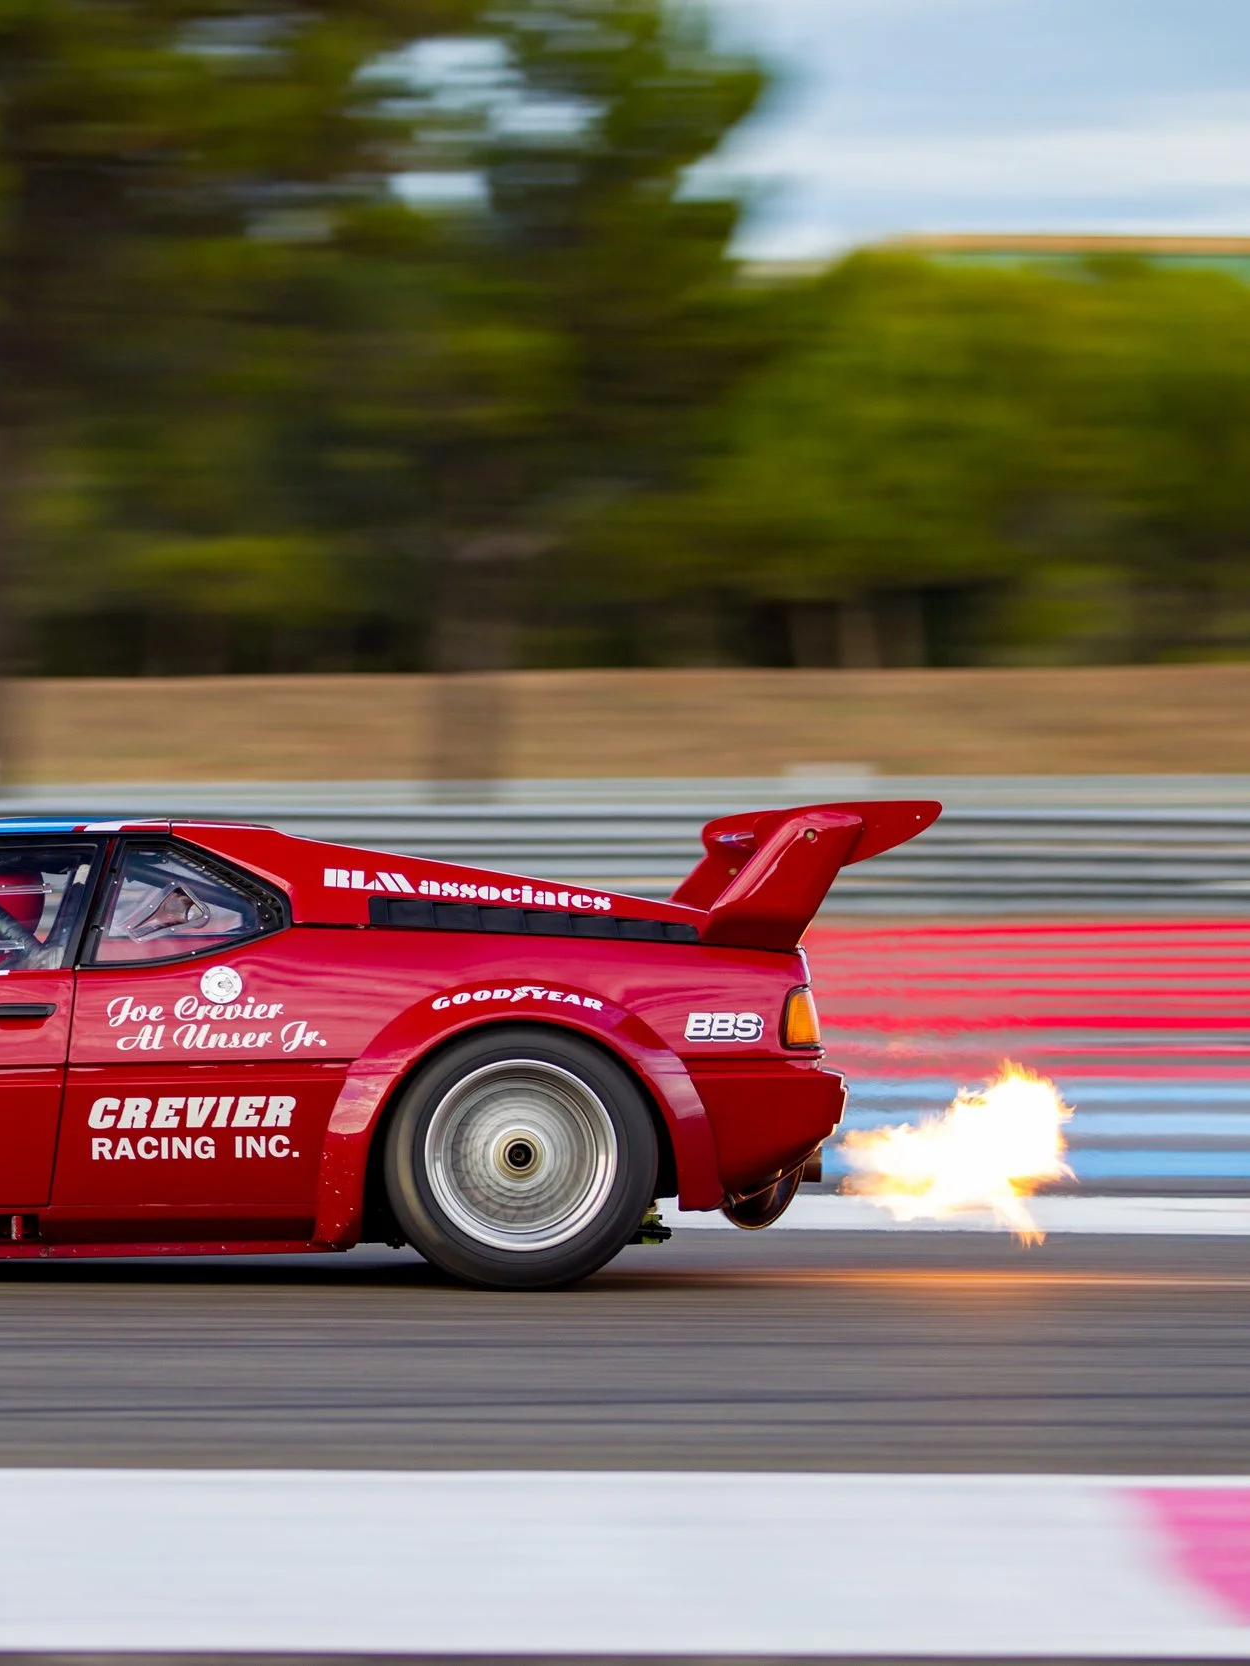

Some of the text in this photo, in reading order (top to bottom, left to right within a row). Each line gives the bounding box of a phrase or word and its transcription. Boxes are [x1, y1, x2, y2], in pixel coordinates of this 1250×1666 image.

[323, 867, 612, 911] RLM associates
[106, 995, 284, 1027] Joe Crevier
[431, 985, 604, 1011] GOODYEAR
[116, 1020, 327, 1052] Al Unser Jr.
[684, 1012, 764, 1042] BBS
[87, 1096, 297, 1130] CREVIER
[91, 1135, 300, 1160] RACING INC.
